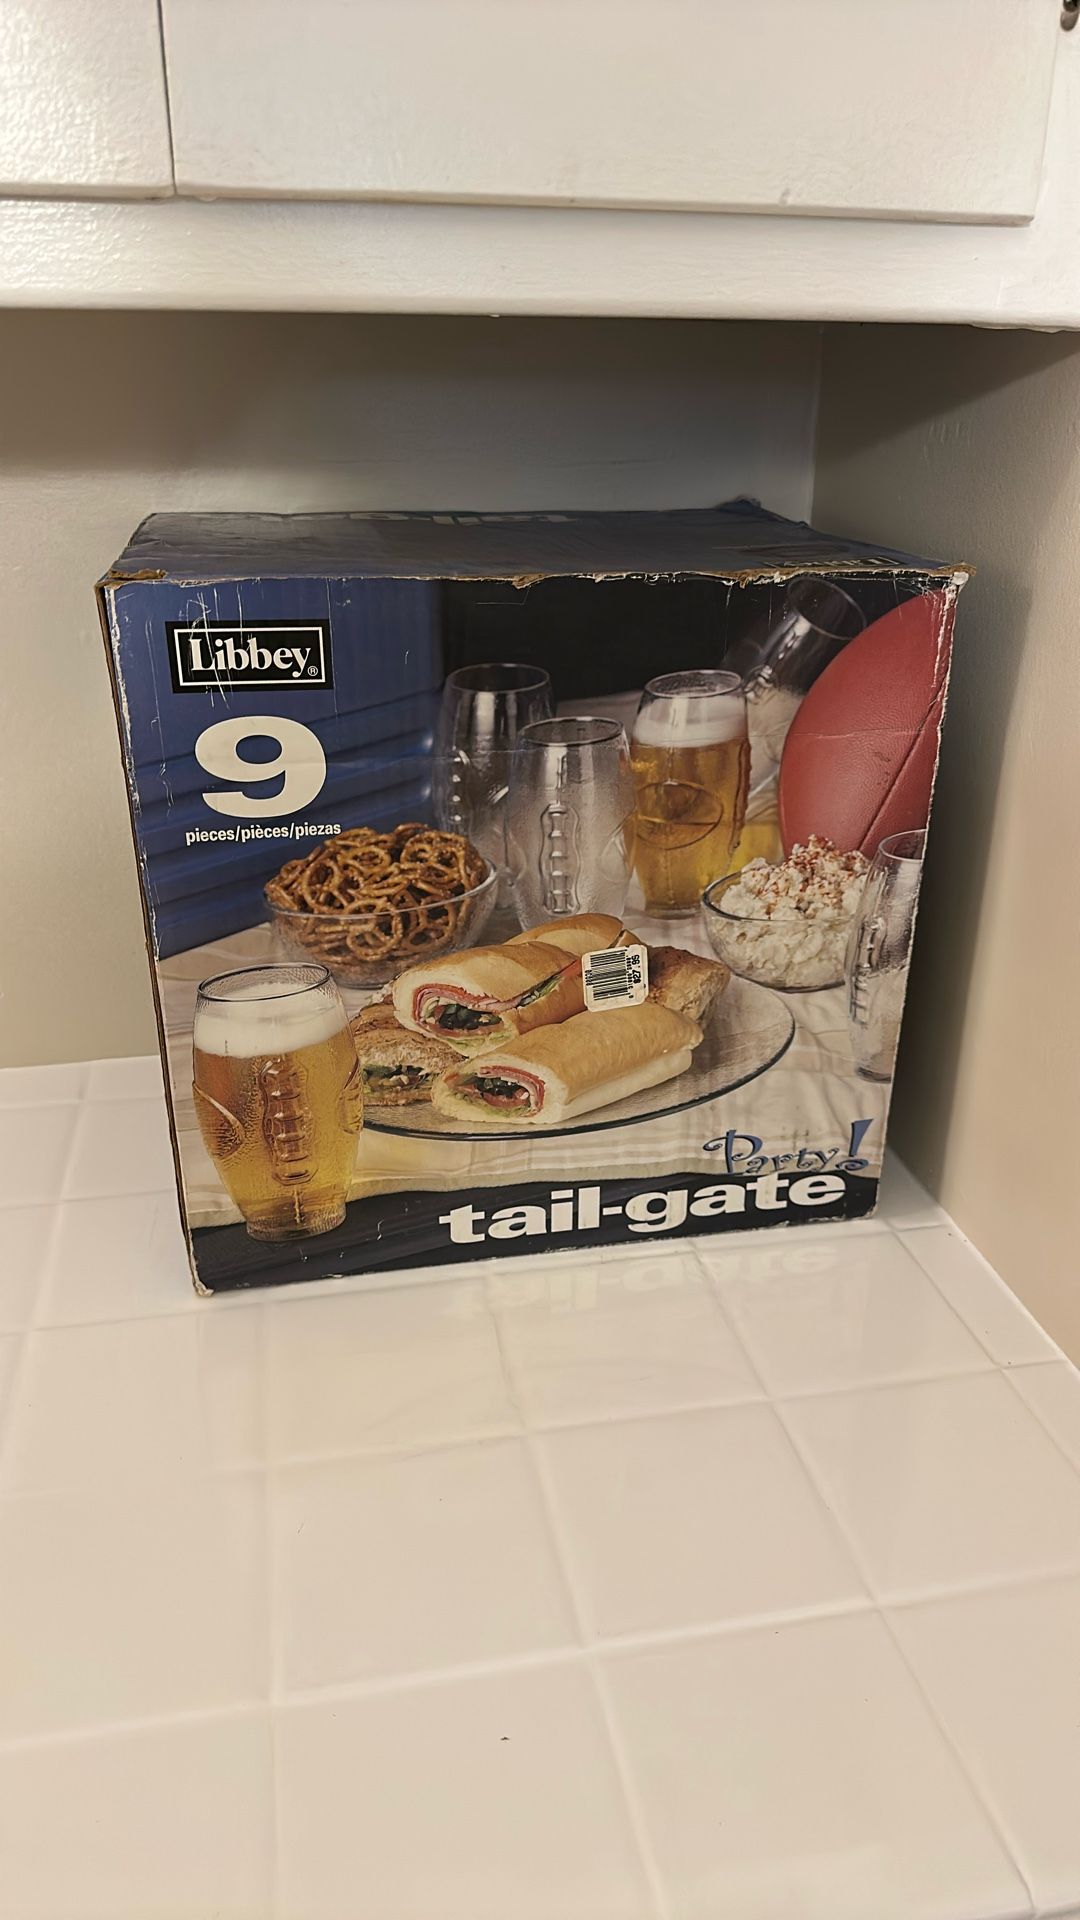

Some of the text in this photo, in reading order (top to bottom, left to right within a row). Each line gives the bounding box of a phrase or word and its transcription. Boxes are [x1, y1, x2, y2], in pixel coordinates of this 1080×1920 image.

[194, 715, 327, 819] 9
[702, 1118, 874, 1176] Party!
[438, 1172, 847, 1245] tail-gate
